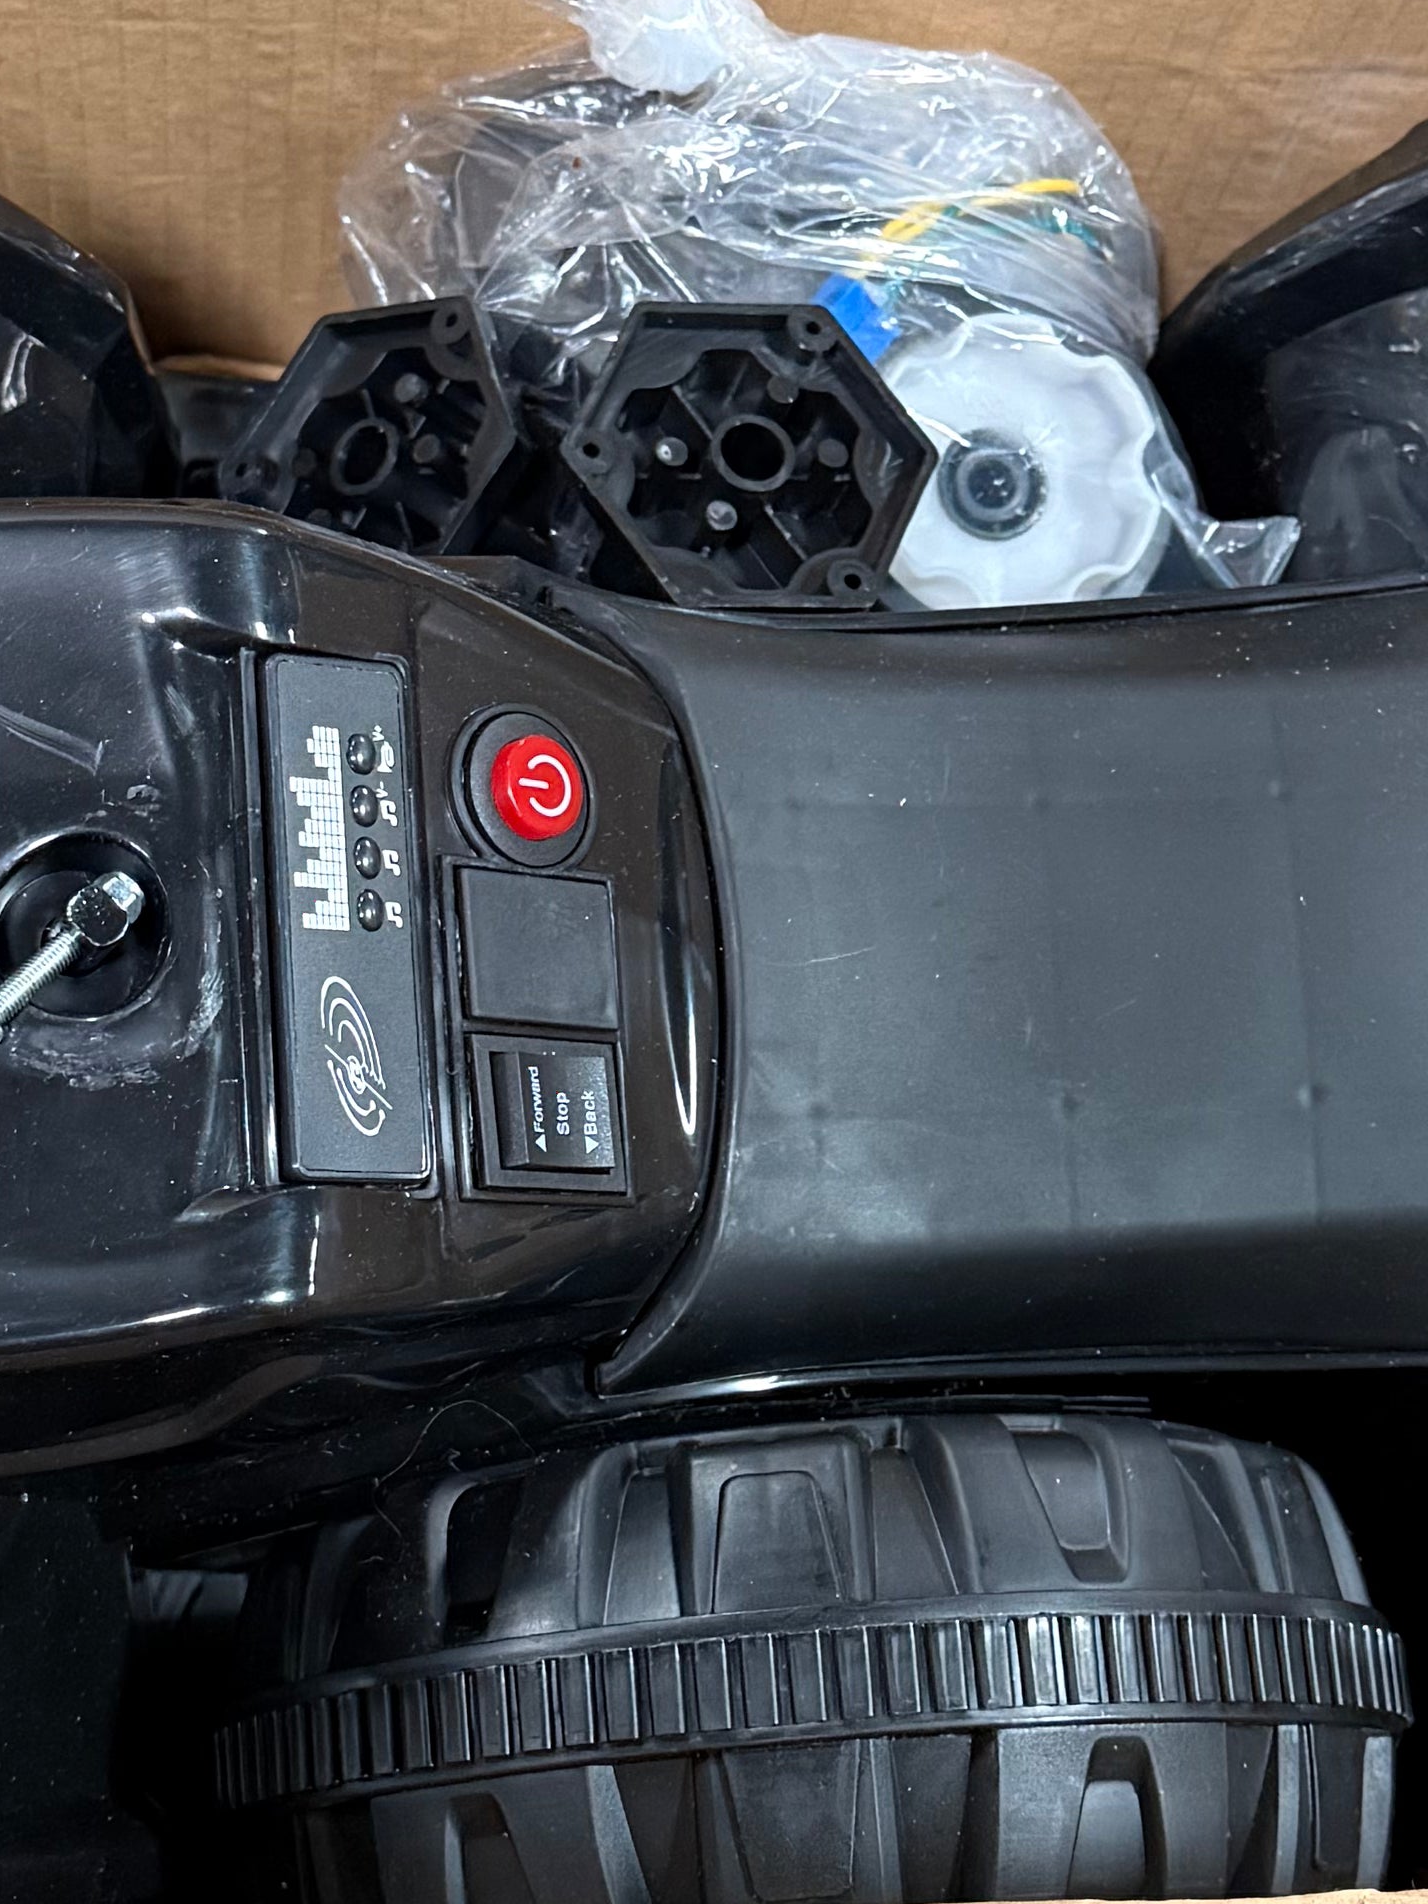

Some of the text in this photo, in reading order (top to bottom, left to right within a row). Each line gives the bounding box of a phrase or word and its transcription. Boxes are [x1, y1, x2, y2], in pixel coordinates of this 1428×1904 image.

[528, 1065, 545, 1133] Forward
[556, 1091, 571, 1136] Stop
[581, 1090, 598, 1135] Back
